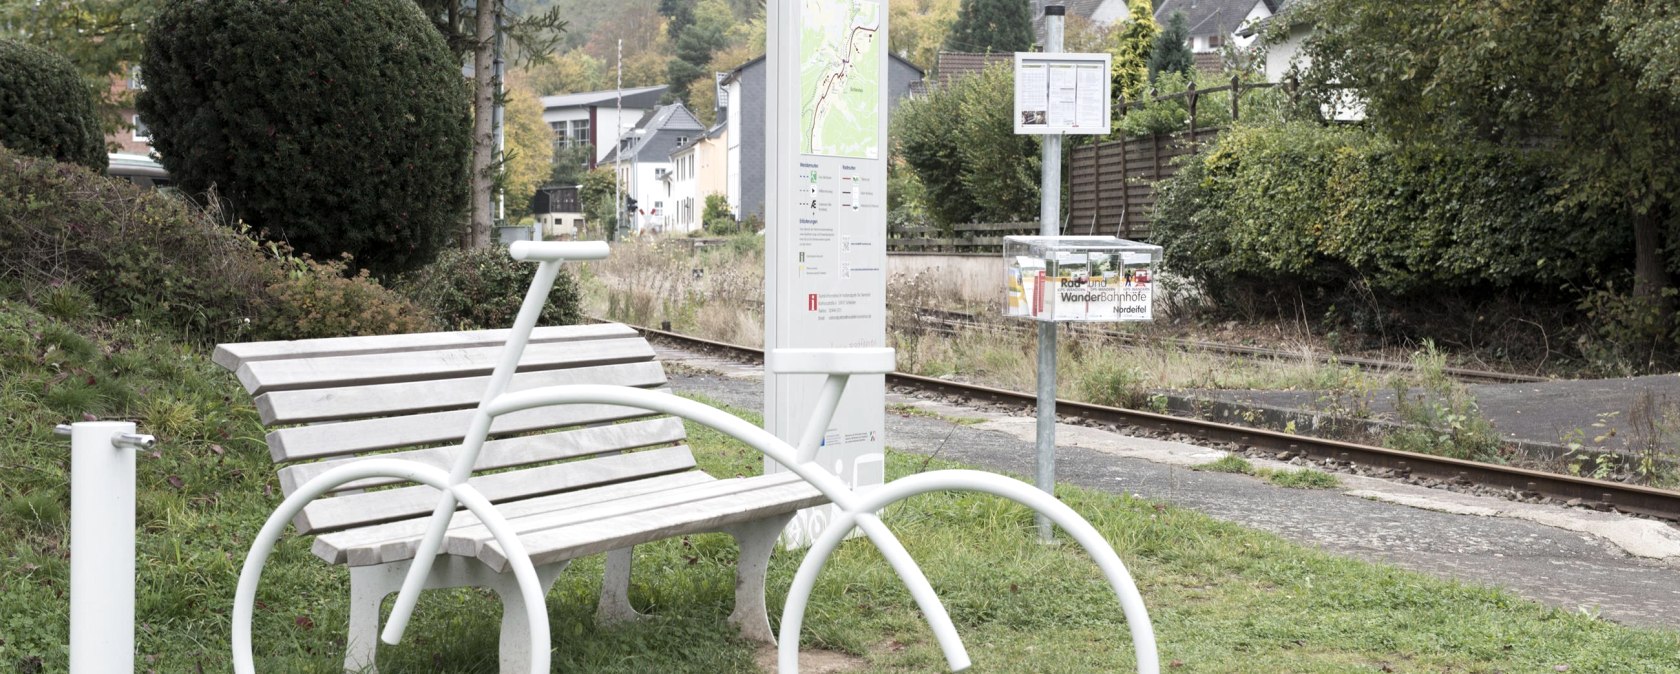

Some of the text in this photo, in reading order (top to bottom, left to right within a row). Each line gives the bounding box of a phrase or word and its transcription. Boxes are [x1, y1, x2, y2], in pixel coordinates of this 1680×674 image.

[1088, 278, 1107, 288] und
[1061, 291, 1147, 302] WanderBahnhöfe
[1113, 305, 1147, 313] Nordeifel
